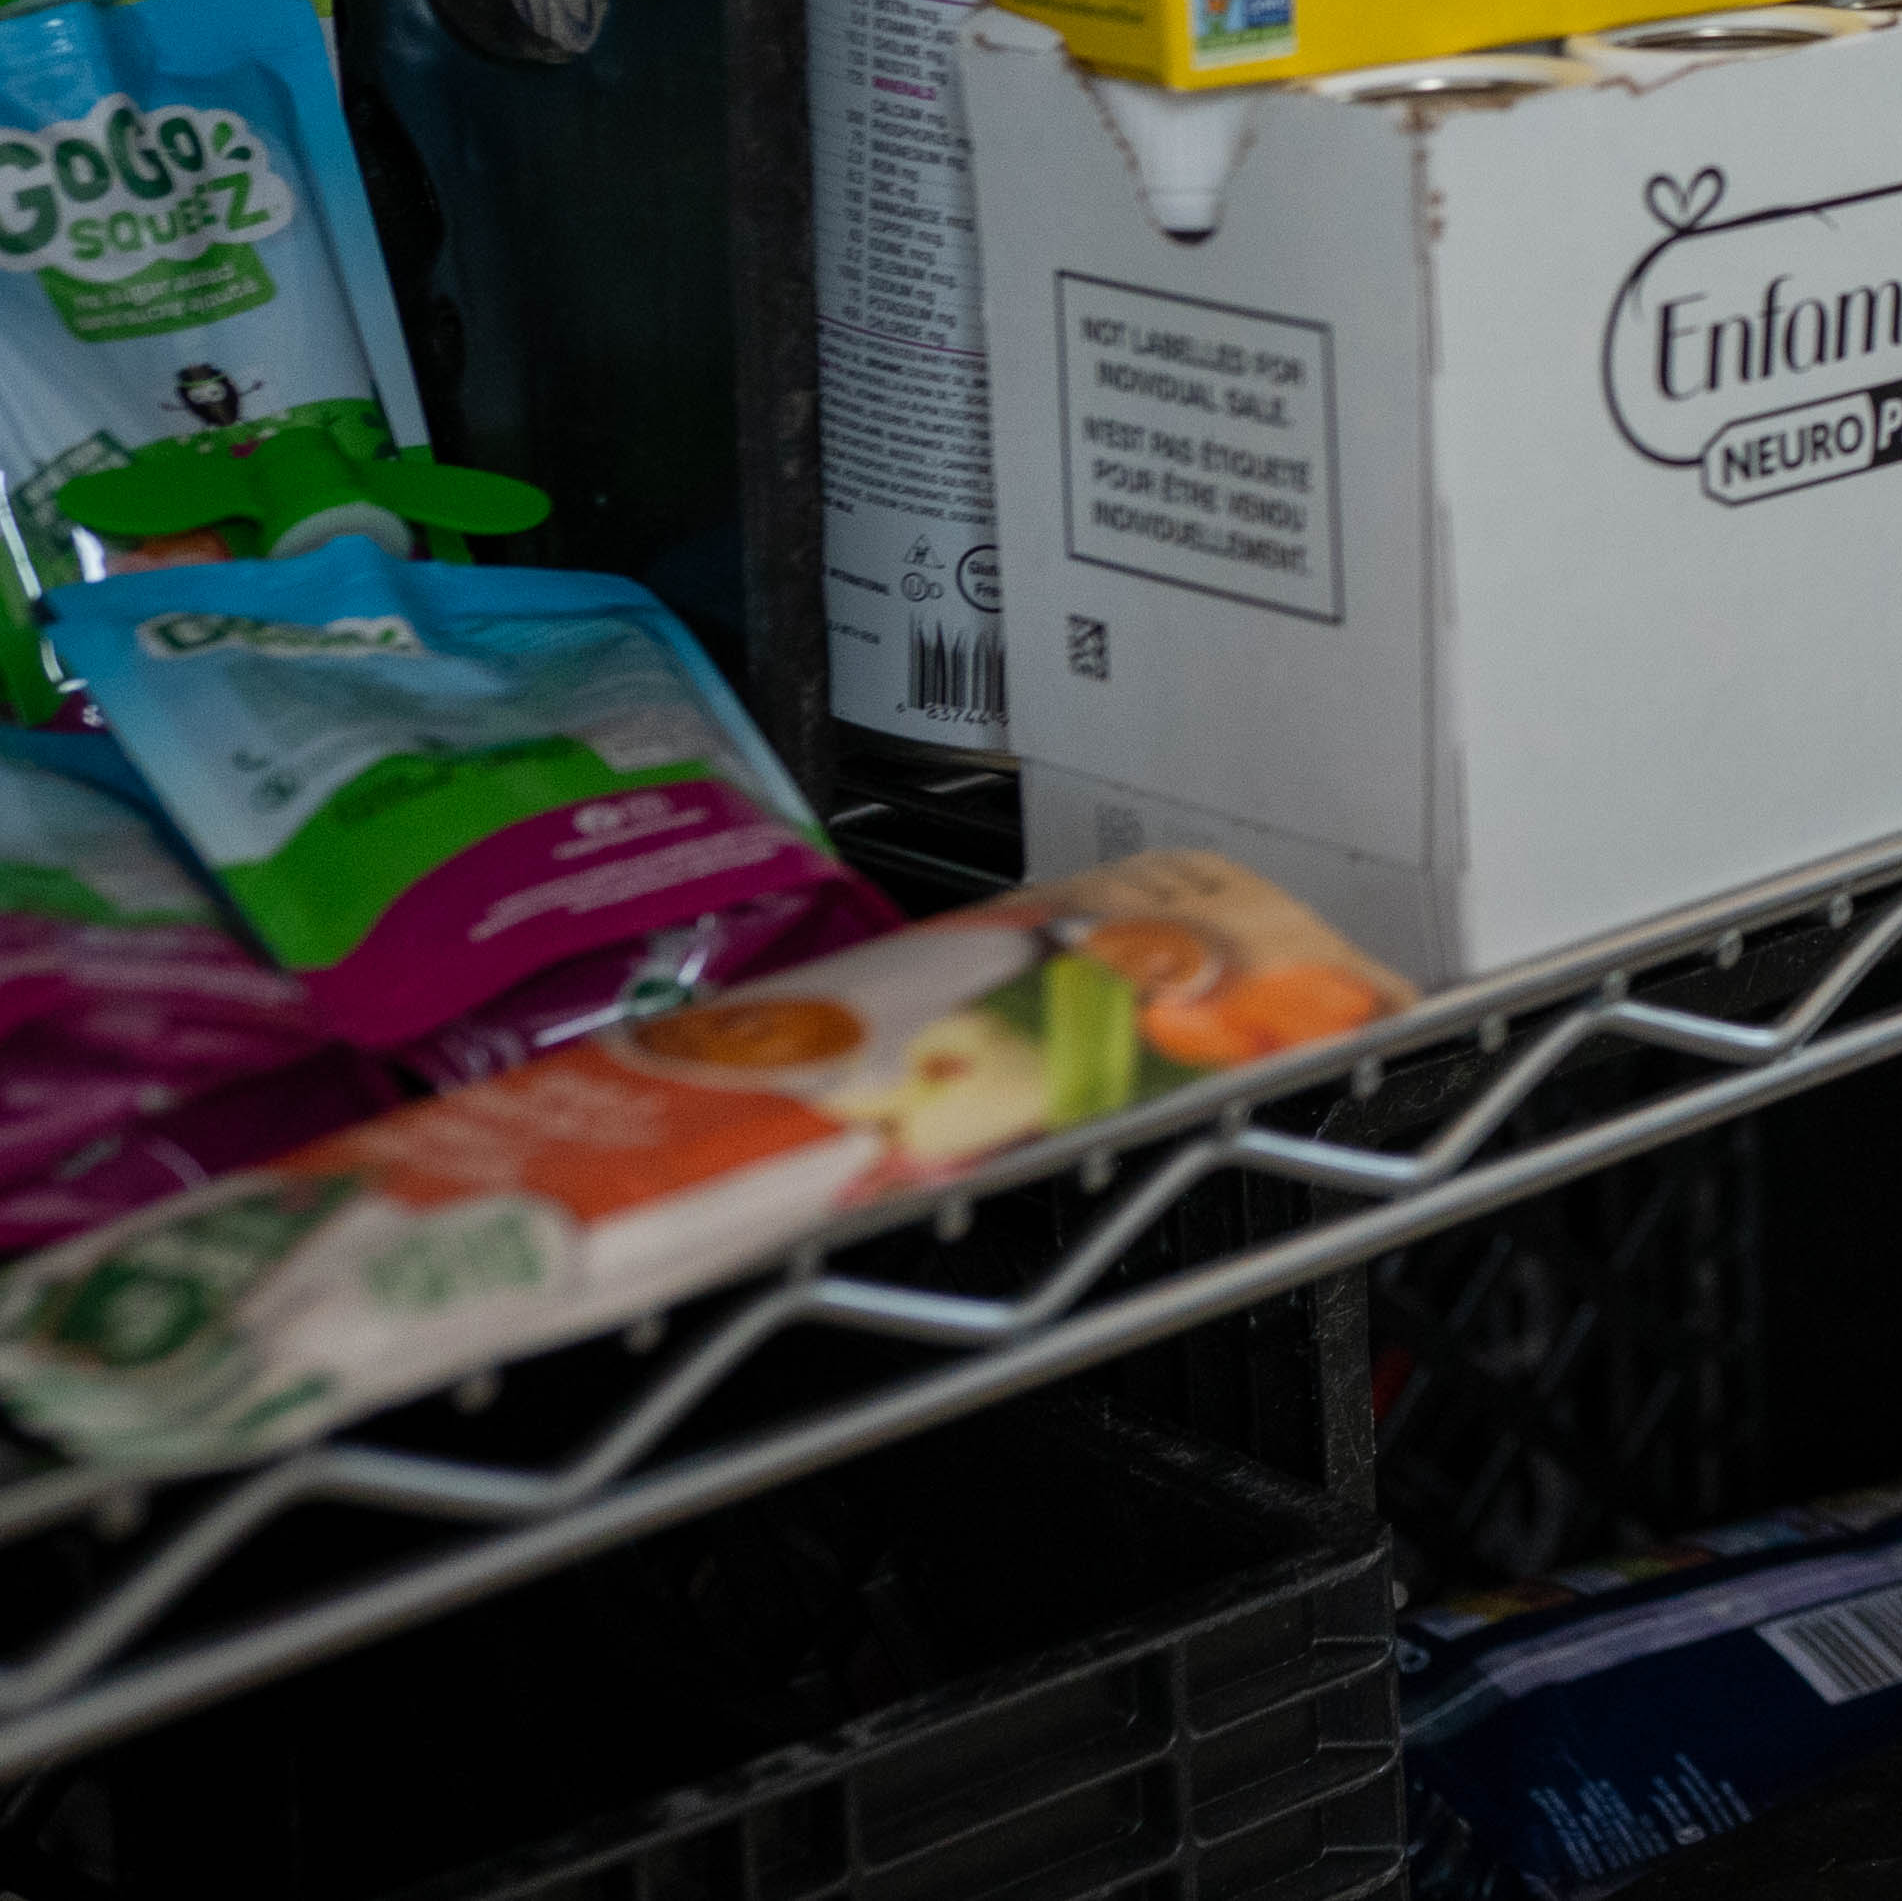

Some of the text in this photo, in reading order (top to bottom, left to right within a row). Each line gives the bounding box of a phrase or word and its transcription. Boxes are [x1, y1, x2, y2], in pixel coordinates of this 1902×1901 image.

[1082, 316, 1306, 385] NOT LABELLED FOR
[1096, 358, 1218, 414] INDIVIDUAL
[1082, 415, 1146, 452] N'EST
[1150, 430, 1193, 466] PAS
[1722, 414, 1862, 485] NEURO
[1094, 456, 1306, 534] POUR ÊTRE VENDU
